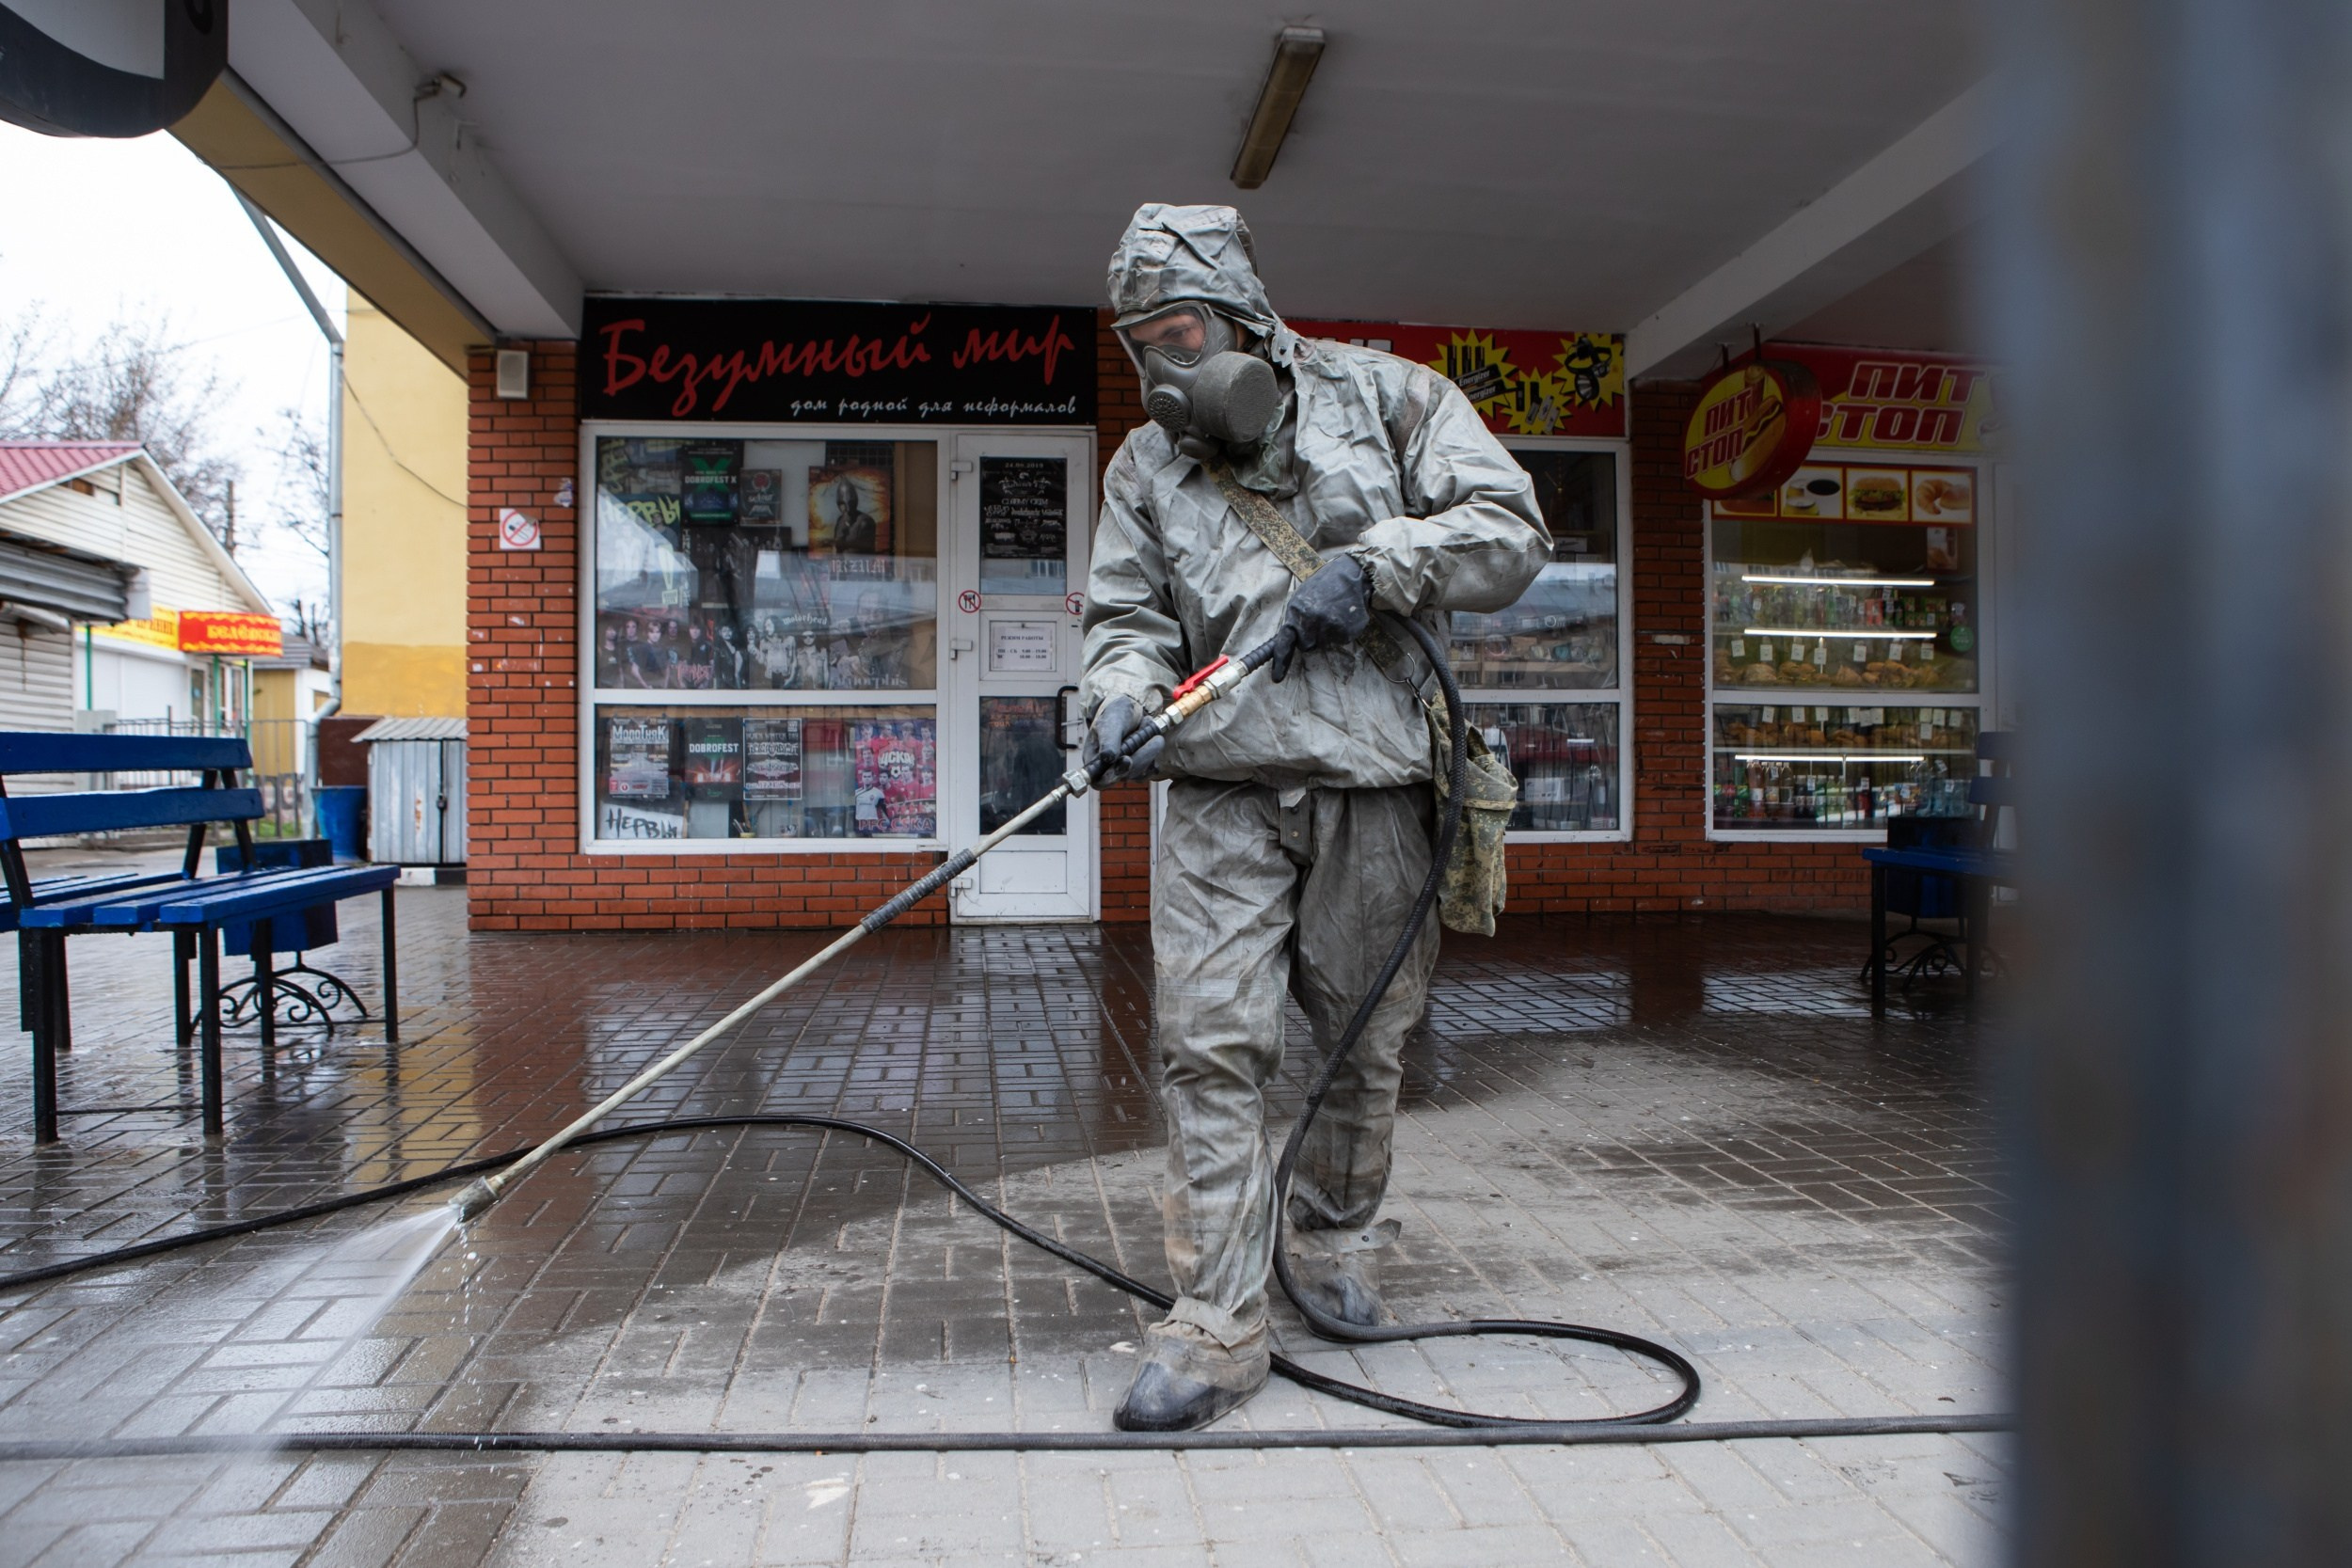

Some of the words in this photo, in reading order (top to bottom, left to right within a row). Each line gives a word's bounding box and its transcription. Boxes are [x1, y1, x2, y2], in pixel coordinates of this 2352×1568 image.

[599, 310, 932, 418] Безумный
[952, 314, 1075, 385] мир
[1458, 370, 1491, 387] Energizer
[1849, 360, 1988, 403] ПИТ
[790, 398, 828, 417] дом
[838, 397, 908, 417] родной
[918, 400, 953, 417] для
[962, 396, 1077, 418] неформалов
[1704, 387, 1754, 437] ПИТ
[1684, 427, 1746, 480] СТОП
[685, 475, 729, 483] DOBROFEST
[730, 475, 737, 483] X
[689, 743, 739, 753] DOBROFEST
[858, 818, 887, 832] PFC
[890, 817, 933, 832] CSKA
